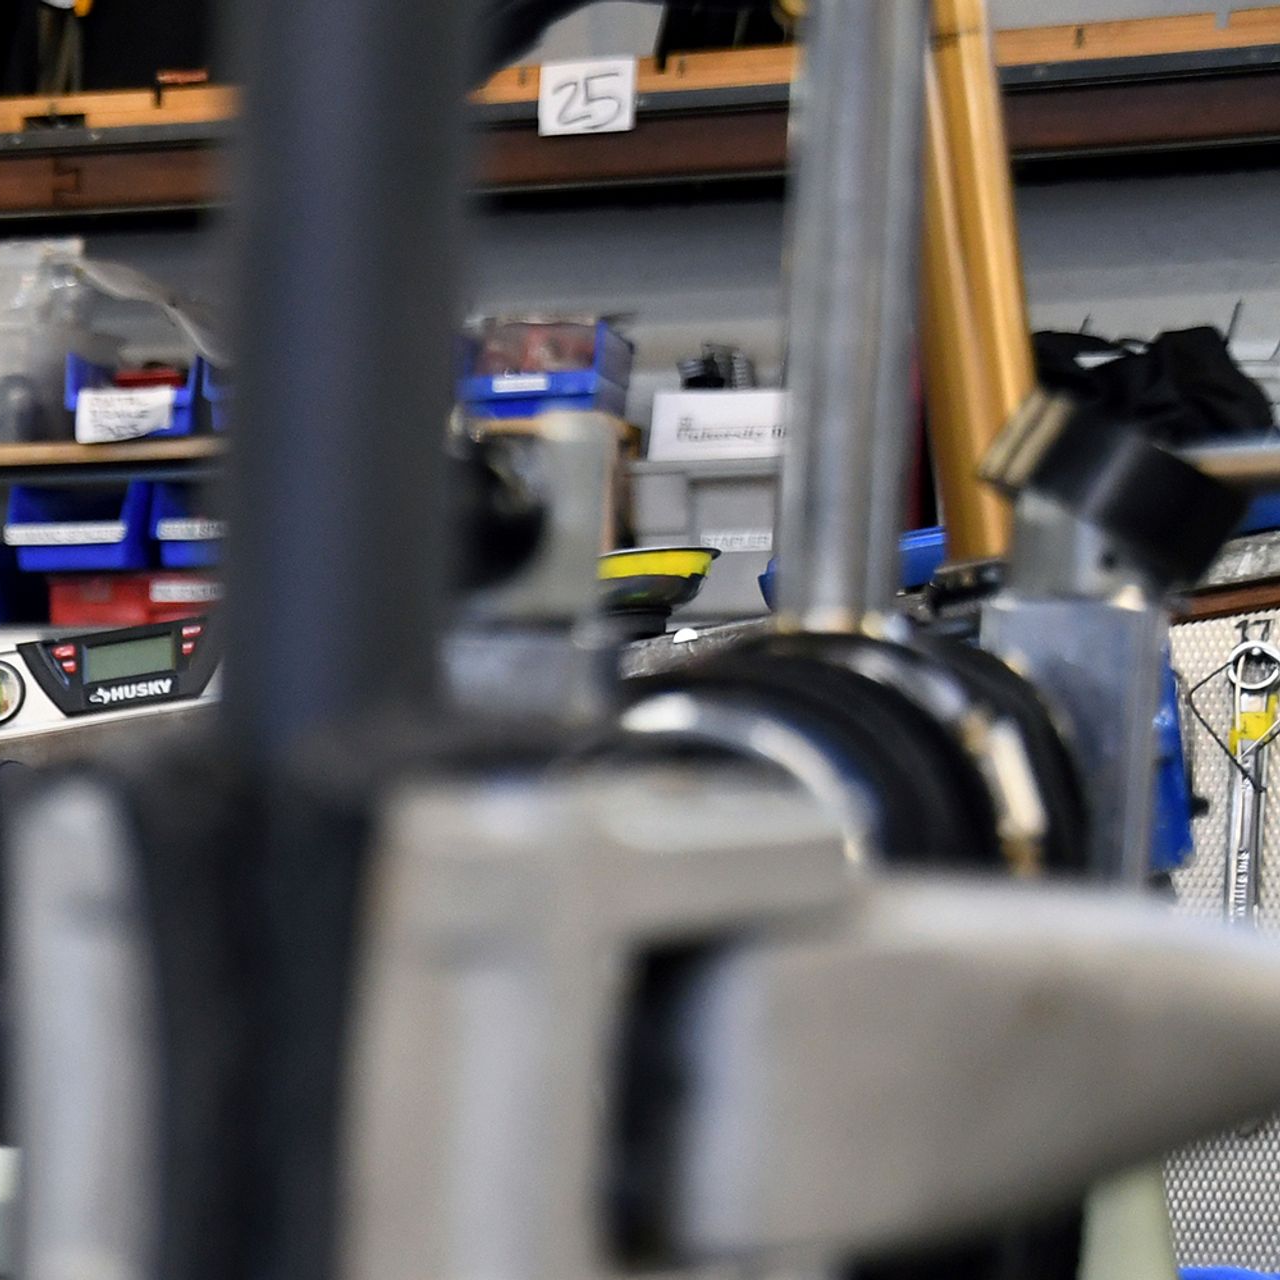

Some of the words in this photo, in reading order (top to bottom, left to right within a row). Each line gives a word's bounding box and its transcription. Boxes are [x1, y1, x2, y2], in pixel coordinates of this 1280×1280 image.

[552, 72, 622, 130] 25
[1235, 618, 1274, 643] 17
[111, 678, 172, 702] HUSKY
